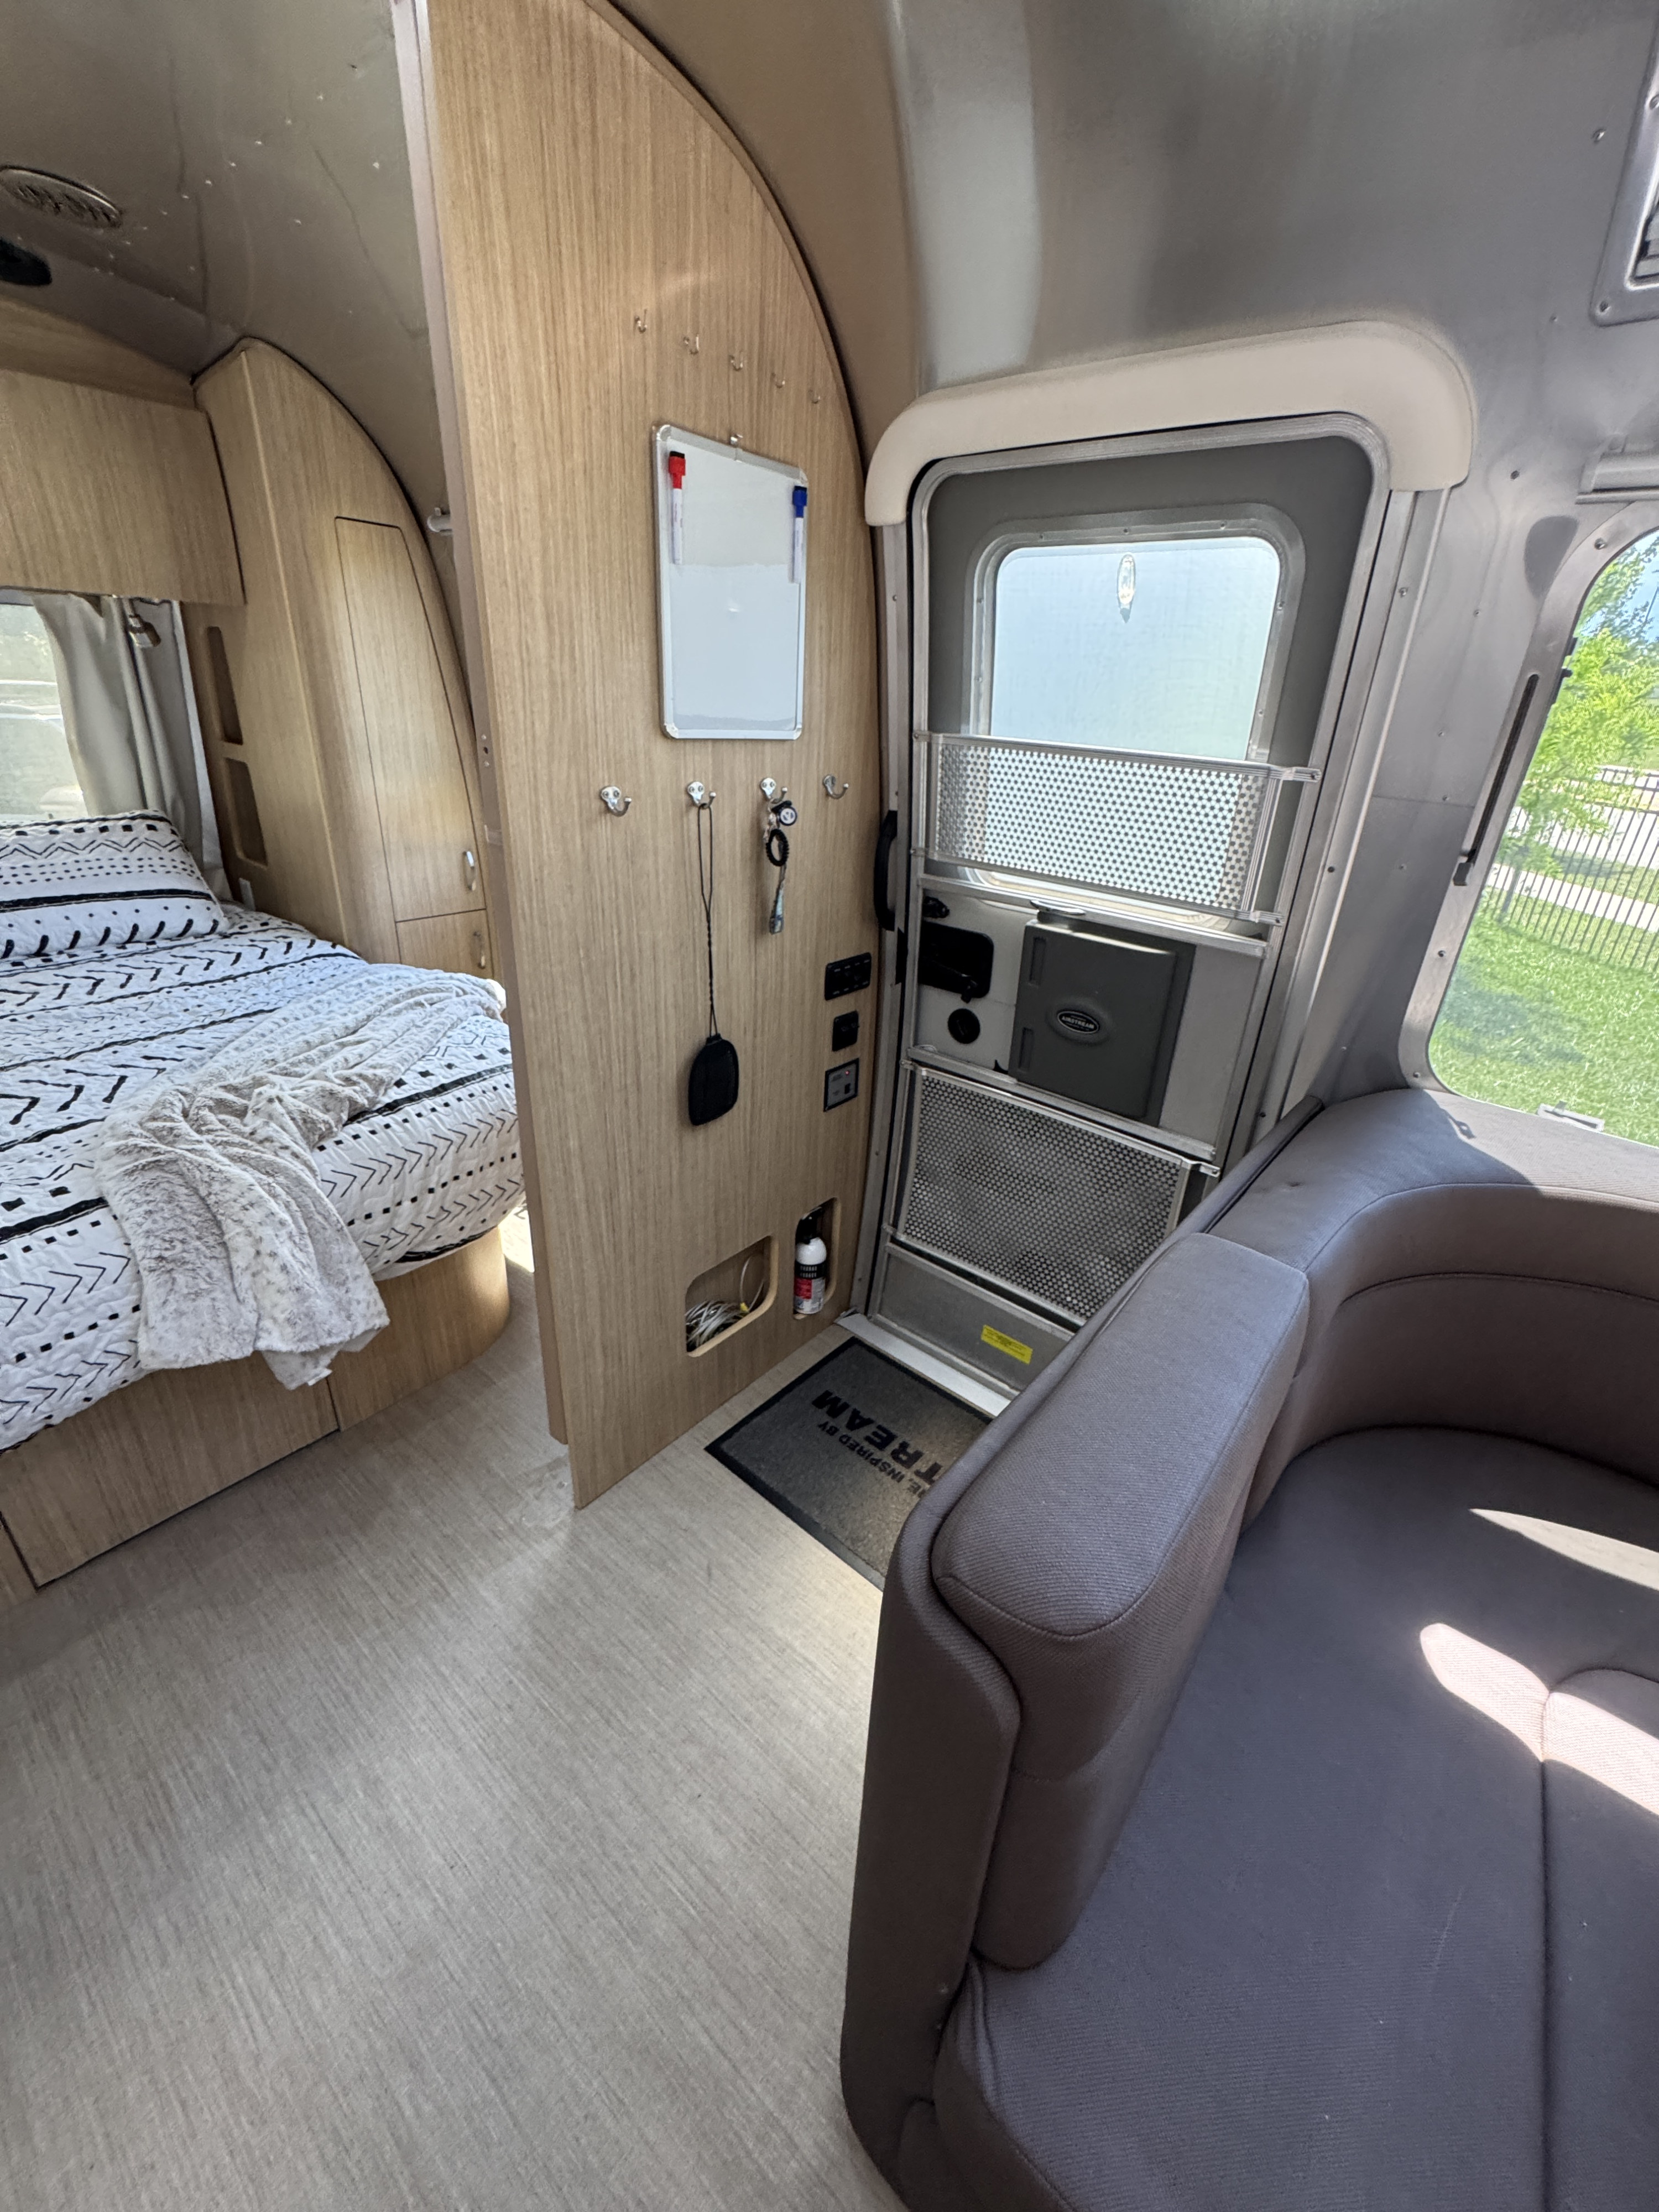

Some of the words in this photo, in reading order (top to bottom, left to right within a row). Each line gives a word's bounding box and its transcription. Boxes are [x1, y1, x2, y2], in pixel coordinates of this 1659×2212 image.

[1062, 1015, 1094, 1029] AIRSTREAM
[818, 1421, 840, 1436] BY
[839, 1433, 905, 1483] INSPIRED
